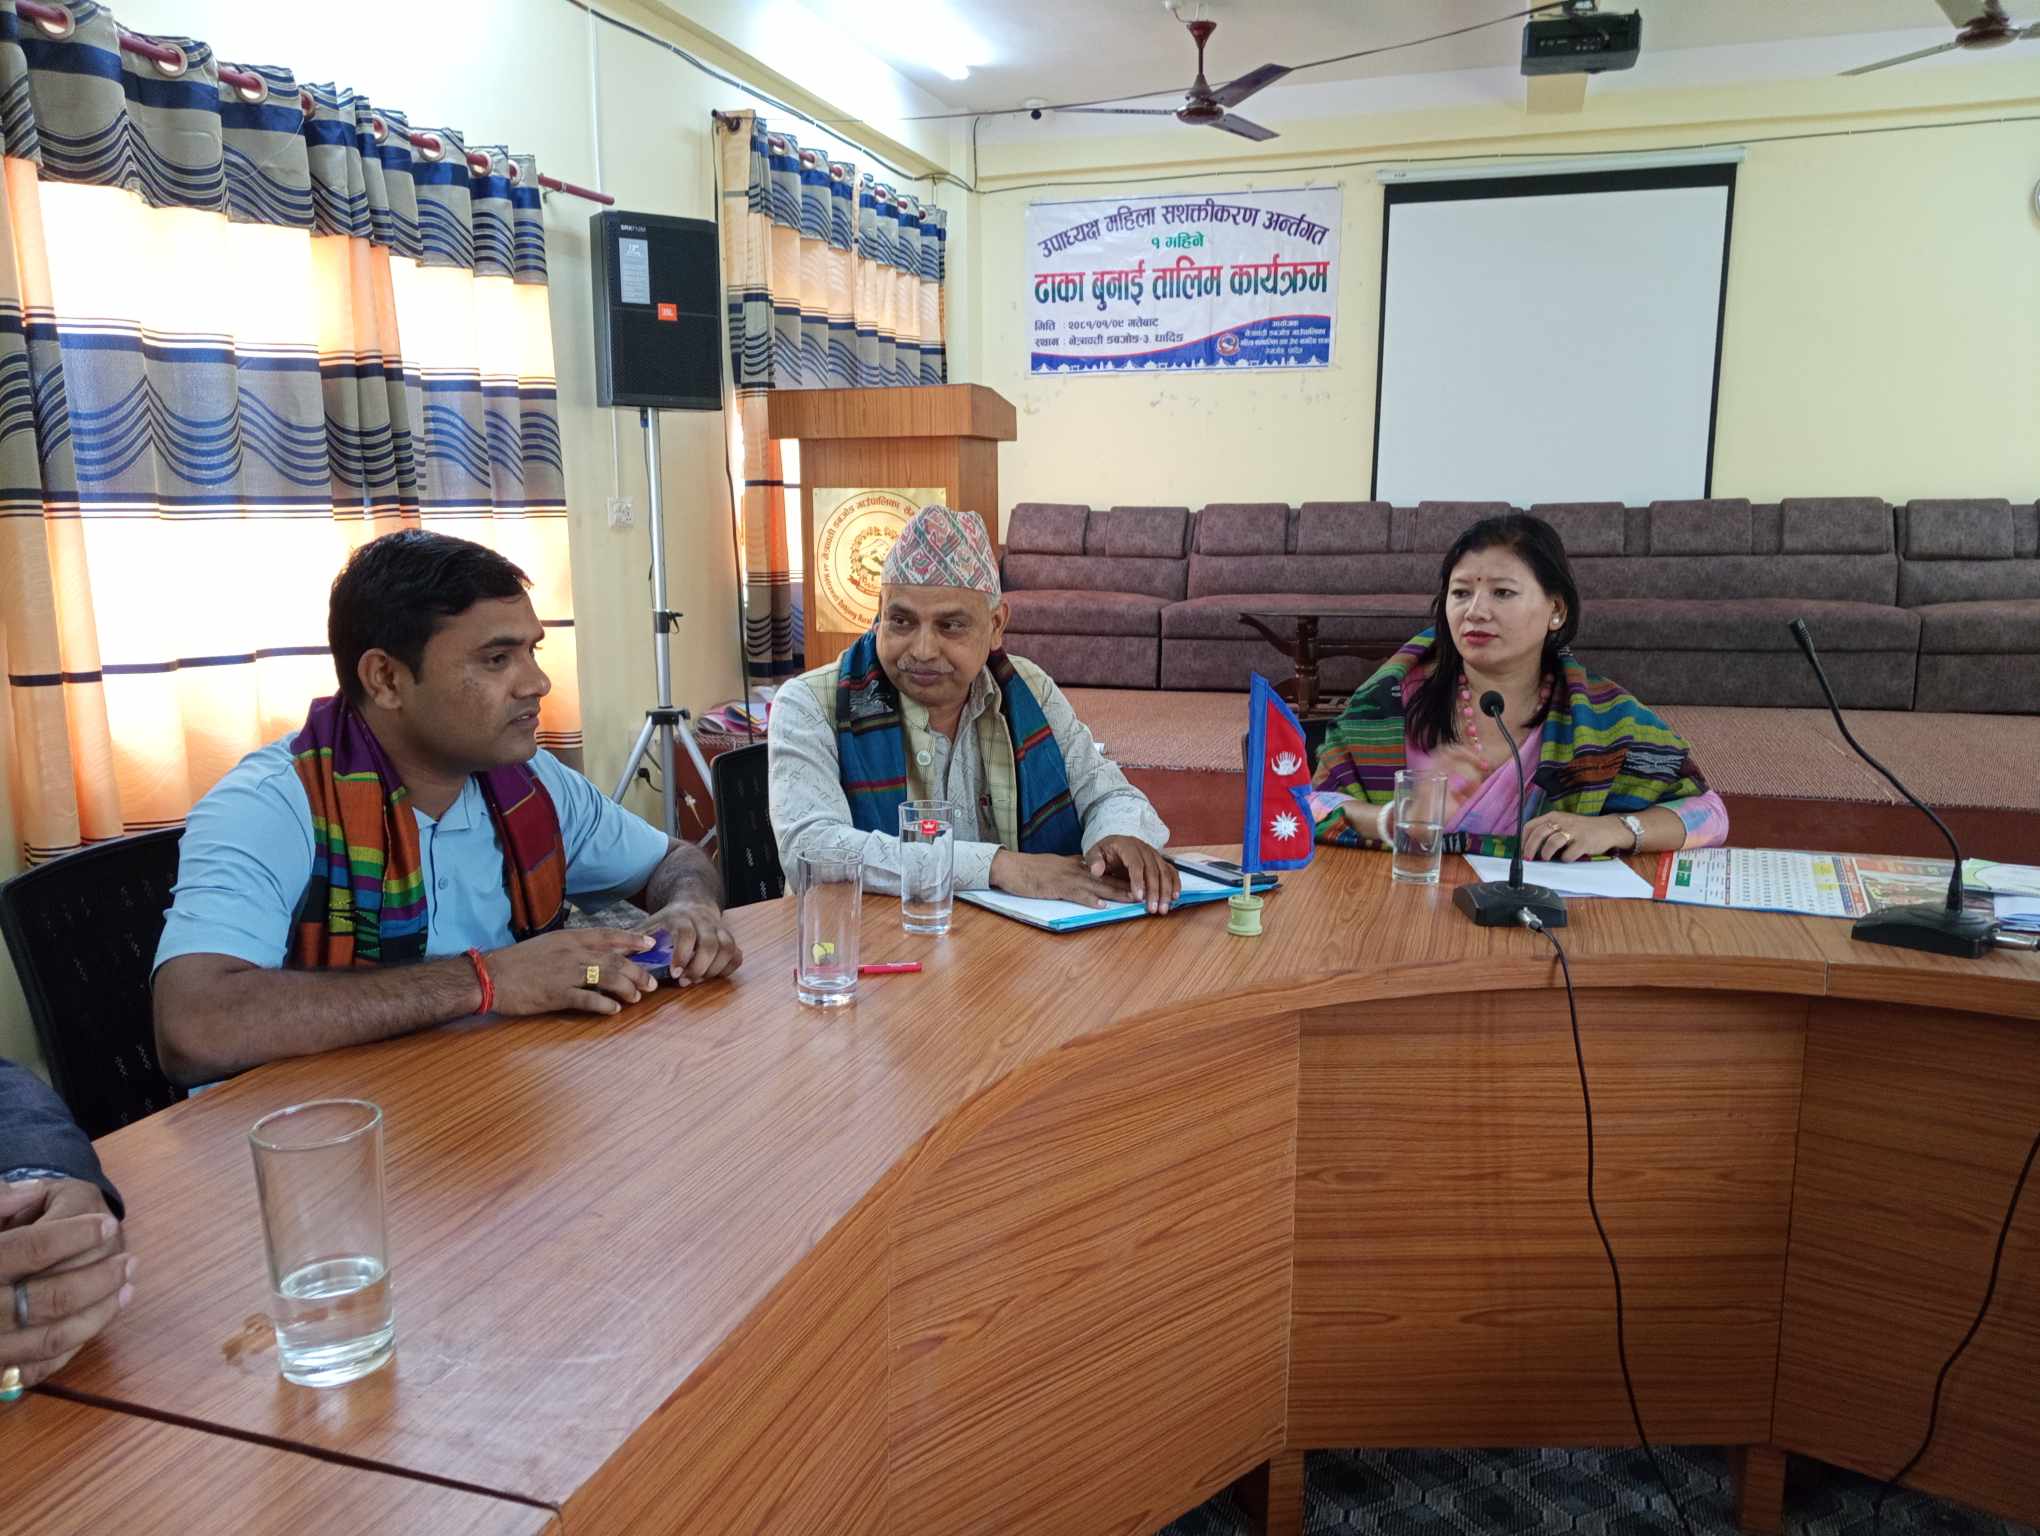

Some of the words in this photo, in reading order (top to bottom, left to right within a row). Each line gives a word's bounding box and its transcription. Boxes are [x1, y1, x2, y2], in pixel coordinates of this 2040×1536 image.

[1037, 218, 1101, 258] उपाध्यक्ष
[1103, 205, 1156, 233] महिला
[1151, 236, 1160, 249] १
[1165, 231, 1205, 249] महिने
[1033, 271, 1086, 304] ढाका
[1092, 259, 1146, 311] बुनाई
[1152, 255, 1224, 300] तालिम
[1229, 252, 1330, 297] कार्यक्रम
[1034, 319, 1056, 331] मिति
